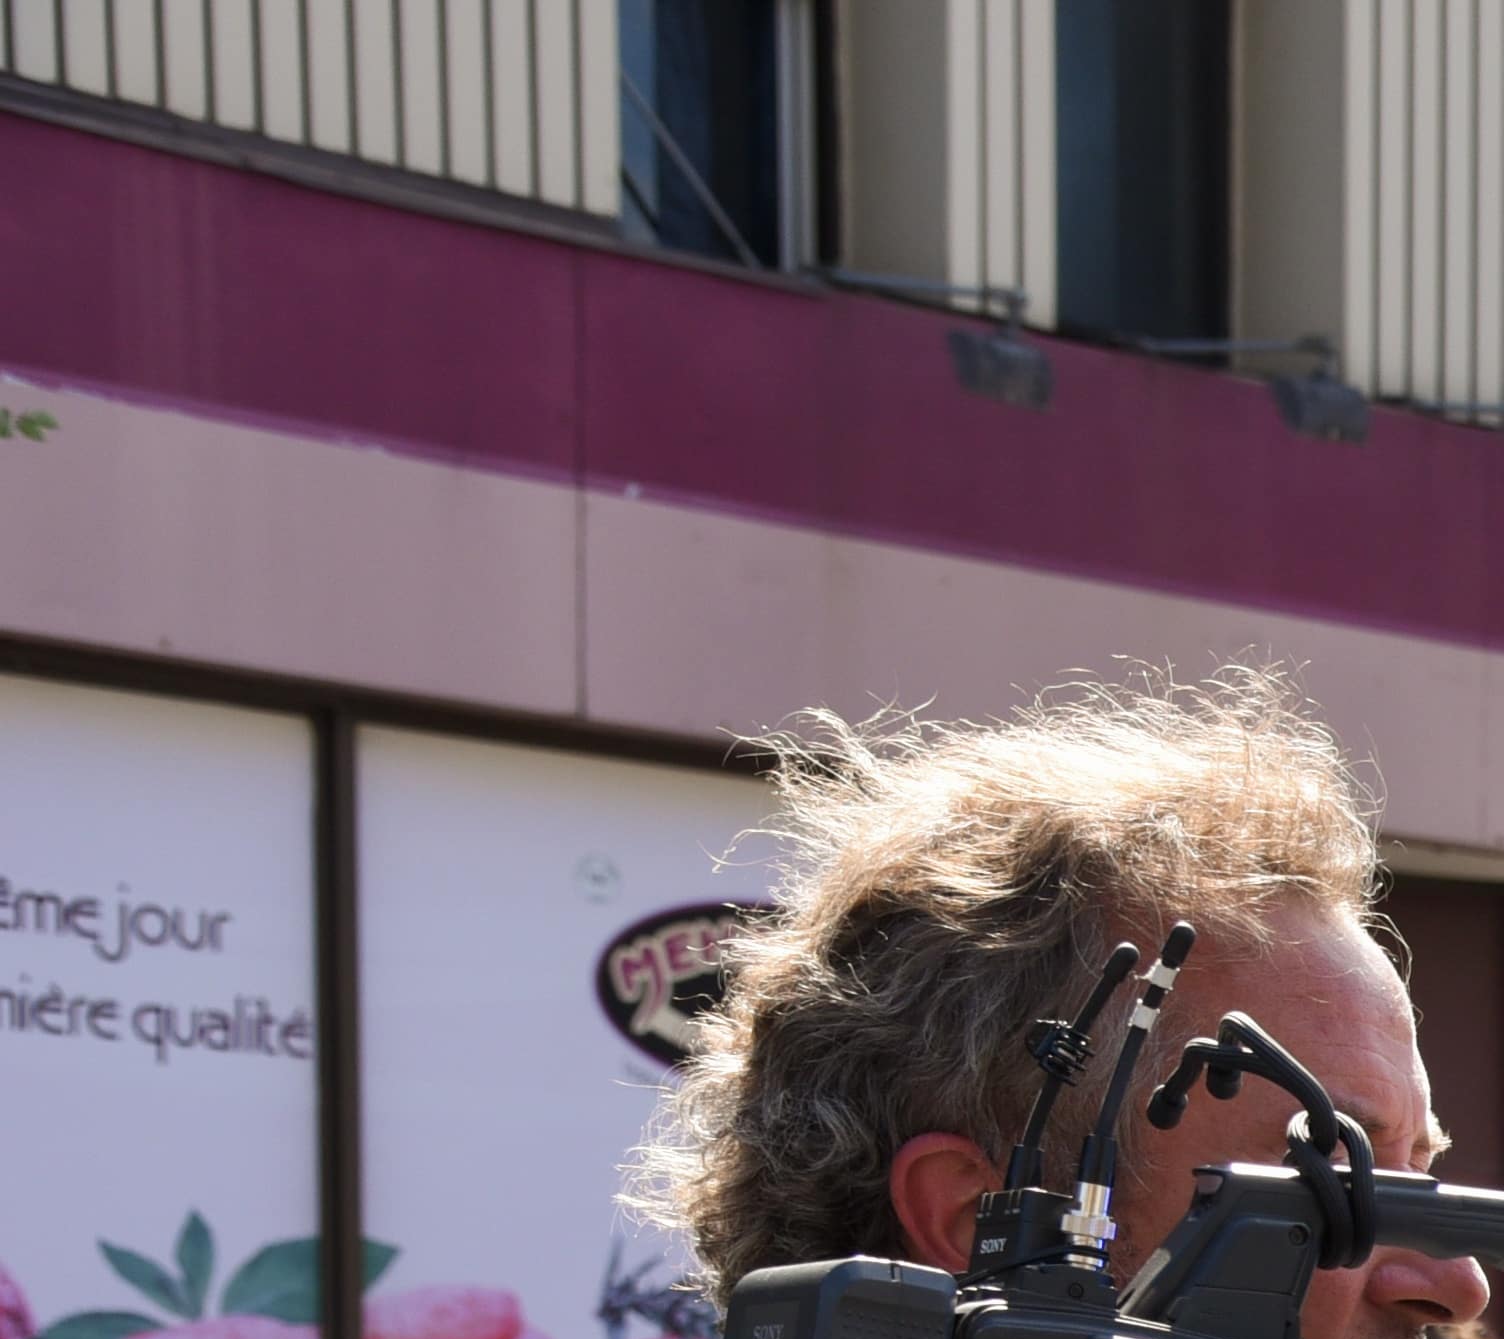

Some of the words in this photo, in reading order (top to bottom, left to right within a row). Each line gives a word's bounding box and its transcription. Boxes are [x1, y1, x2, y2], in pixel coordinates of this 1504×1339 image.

[94, 881, 233, 963] jour
[131, 992, 313, 1066] qualité
[980, 1238, 1007, 1254] SONY
